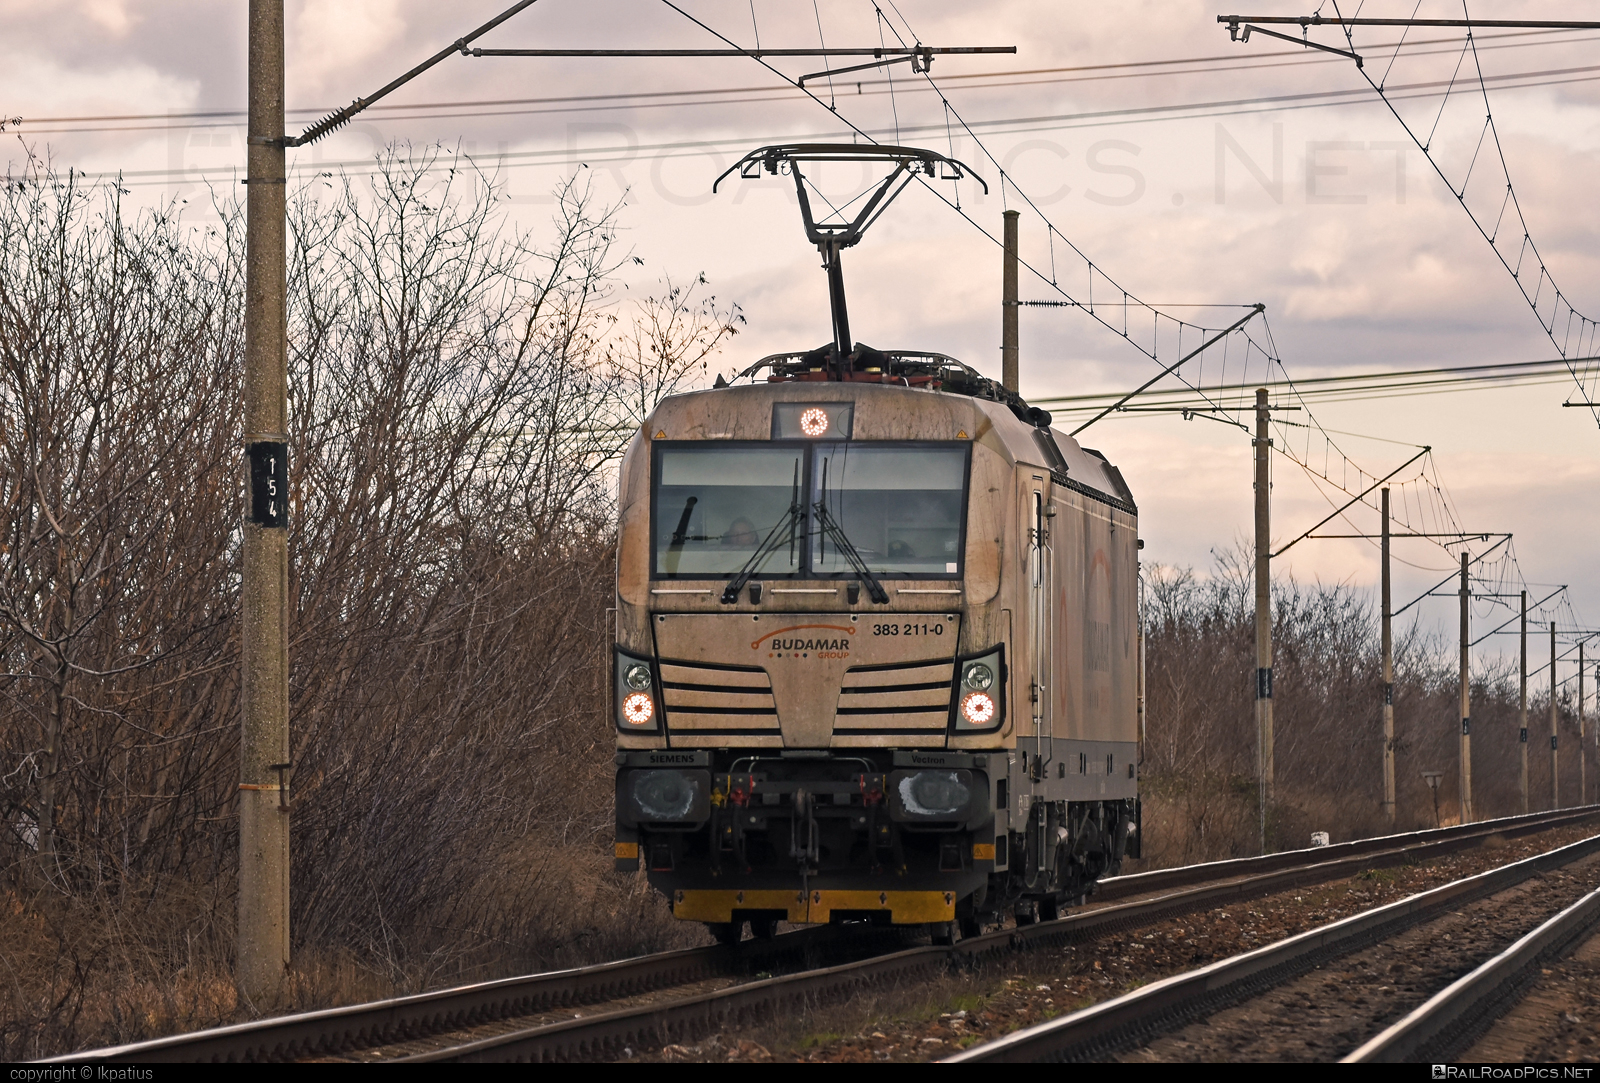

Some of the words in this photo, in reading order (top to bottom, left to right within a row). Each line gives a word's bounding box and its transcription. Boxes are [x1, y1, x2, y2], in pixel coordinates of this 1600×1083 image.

[872, 623, 900, 636] 383
[903, 623, 944, 636] 211-0
[771, 638, 850, 650] BUDAMAR
[817, 651, 850, 659] GROUP
[649, 754, 695, 763] SIEMENS
[911, 755, 945, 764] Vectron
